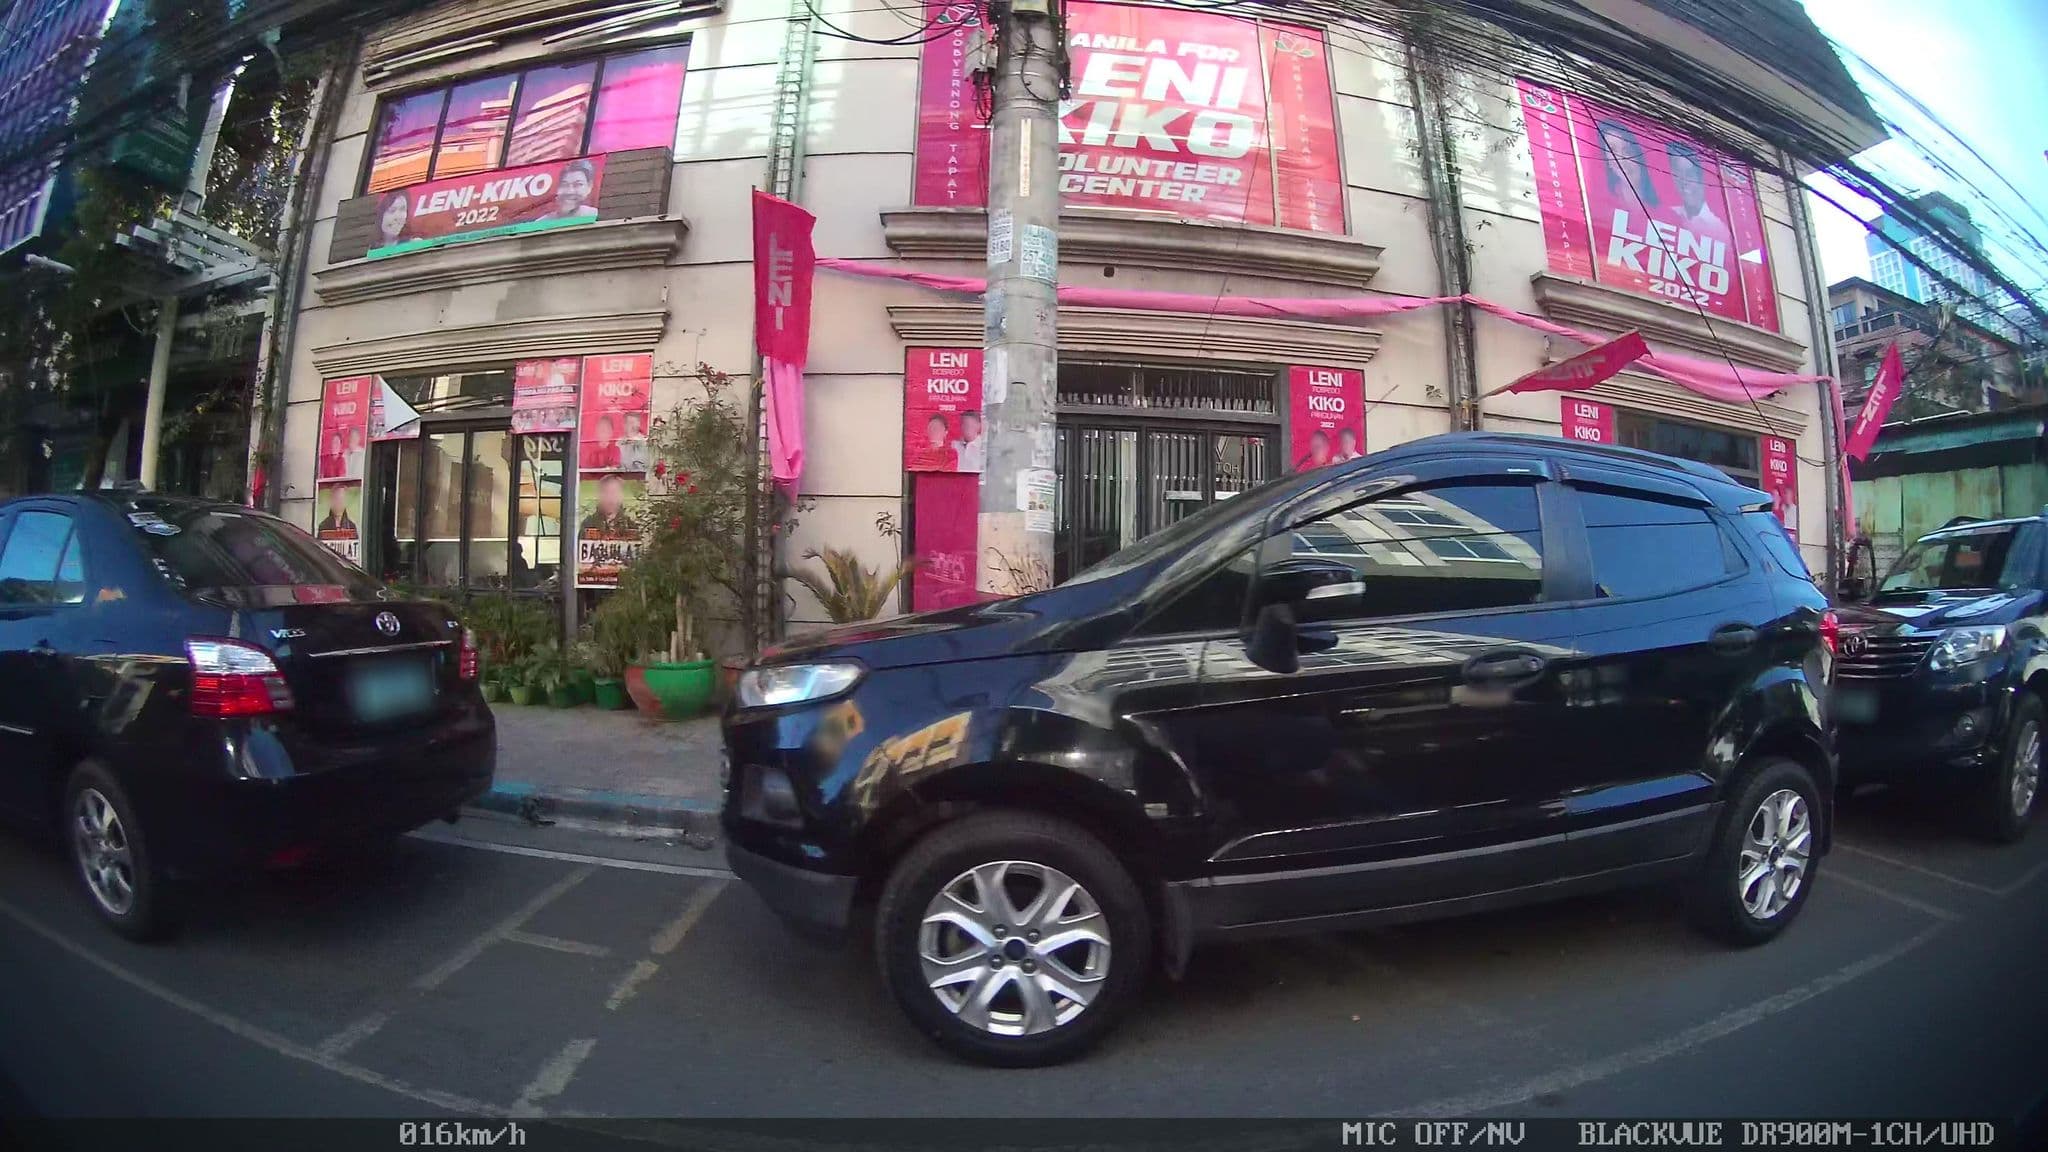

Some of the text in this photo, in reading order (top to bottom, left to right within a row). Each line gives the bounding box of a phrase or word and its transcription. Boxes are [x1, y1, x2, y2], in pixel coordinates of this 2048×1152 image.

[1070, 32, 1241, 62] ANILA FOR
[1077, 52, 1250, 109] ENI
[946, 144, 960, 200] TAPAT
[1058, 152, 1243, 187] OLUNTEER
[414, 173, 553, 217] LENI-KIKO
[1058, 174, 1208, 203] CENTER
[455, 206, 500, 227] 2022
[1612, 209, 1727, 267] LENI
[1607, 236, 1730, 295] KIKO
[767, 232, 794, 331] LENI
[1649, 278, 1710, 307] 2022
[929, 352, 969, 368] LENI
[598, 383, 634, 397] KIKO
[927, 378, 969, 394] KIKO
[1309, 371, 1343, 387] LENI
[1308, 396, 1345, 412] KIKO
[1574, 403, 1599, 419] LENI
[1574, 425, 1601, 442] KIKO
